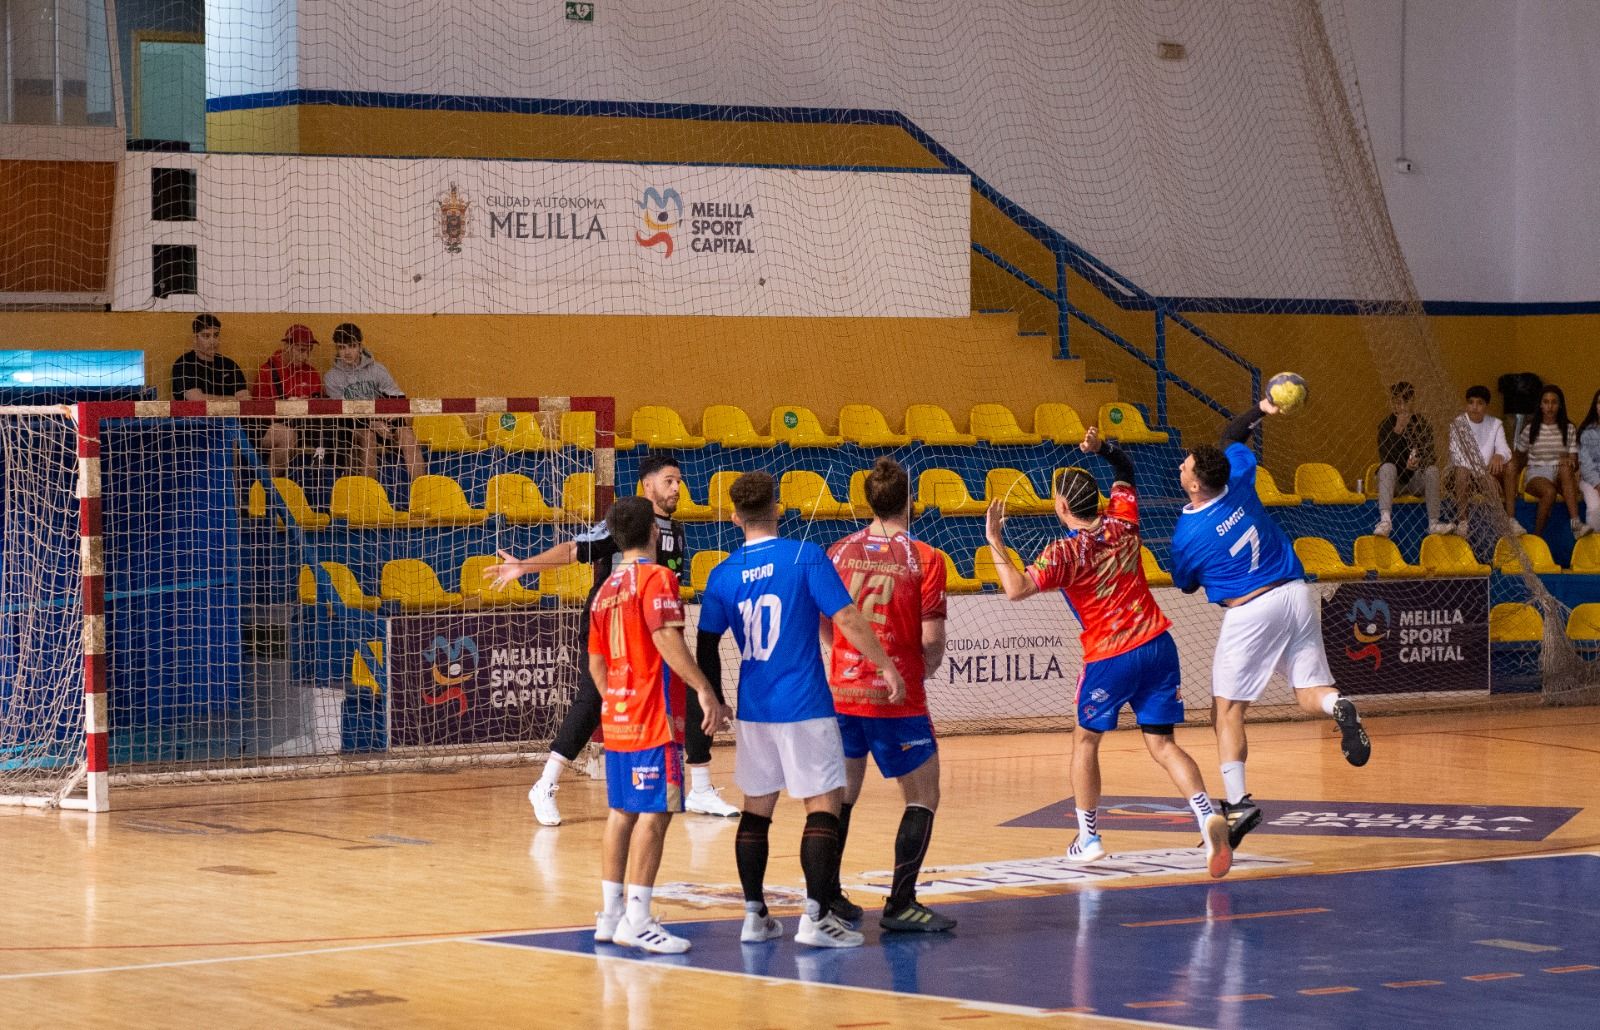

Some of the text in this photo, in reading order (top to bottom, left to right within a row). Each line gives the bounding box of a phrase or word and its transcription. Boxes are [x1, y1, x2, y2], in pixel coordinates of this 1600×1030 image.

[486, 195, 606, 210] CIUDAD AUTÓNOMA
[691, 202, 755, 219] MELILLA
[490, 211, 607, 240] MELILLA
[691, 219, 742, 236] SPORT
[691, 237, 755, 254] CAPITAL
[661, 534, 675, 552] 10
[1228, 524, 1261, 574] 7
[1399, 609, 1464, 626] MELILLA
[737, 593, 782, 661] 10
[1399, 627, 1452, 645] SPORT
[946, 635, 1063, 651] CIUDAD AUTÓNOMA
[490, 646, 571, 667] MELILLA
[1399, 645, 1465, 663] CAPITAL
[490, 667, 556, 687] SPORT
[948, 653, 1064, 684] MELILLA
[491, 688, 572, 709] CAPITAL
